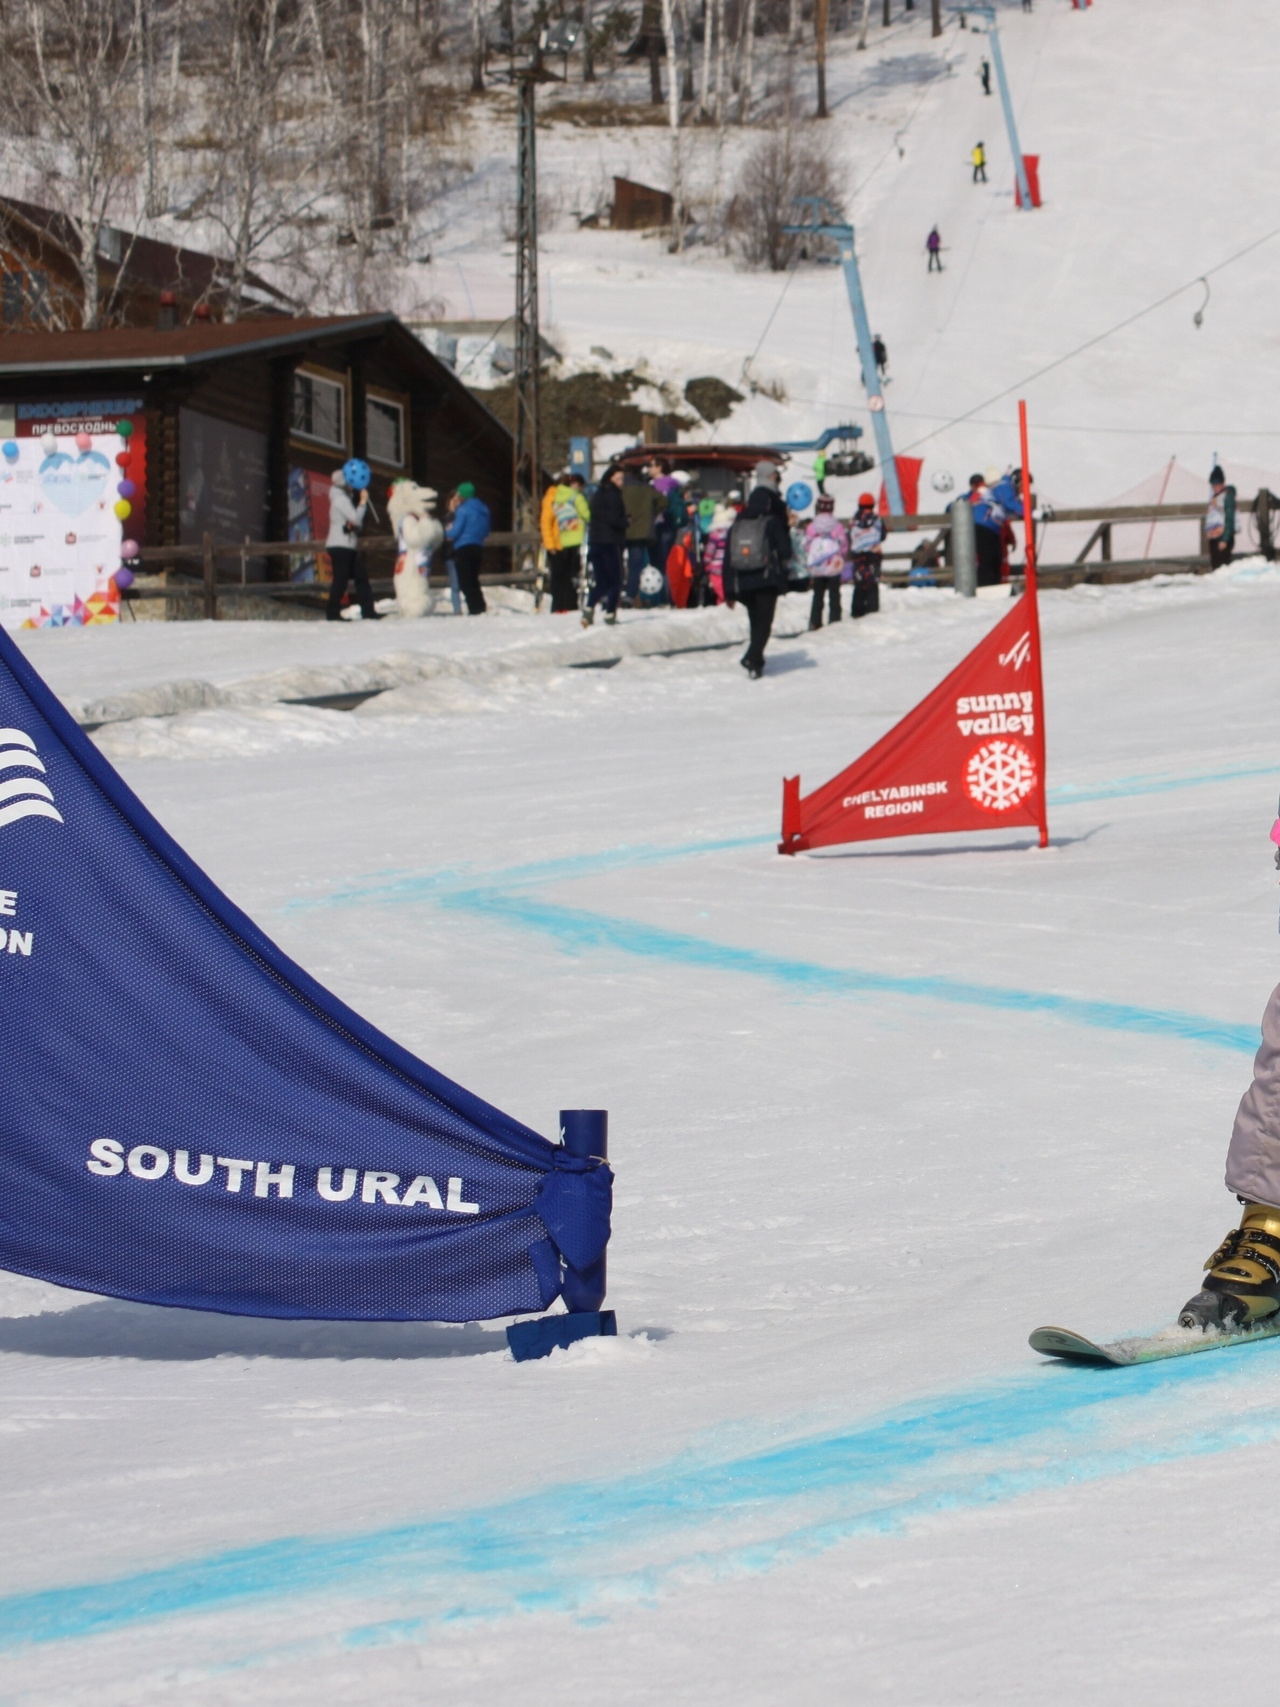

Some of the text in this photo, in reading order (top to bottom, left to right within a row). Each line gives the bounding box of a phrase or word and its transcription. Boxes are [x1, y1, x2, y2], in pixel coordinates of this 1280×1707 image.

[957, 691, 1033, 714] sunny
[957, 713, 1034, 736] valley
[864, 800, 924, 819] REGION
[86, 1138, 480, 1214] SOUTH URAL
